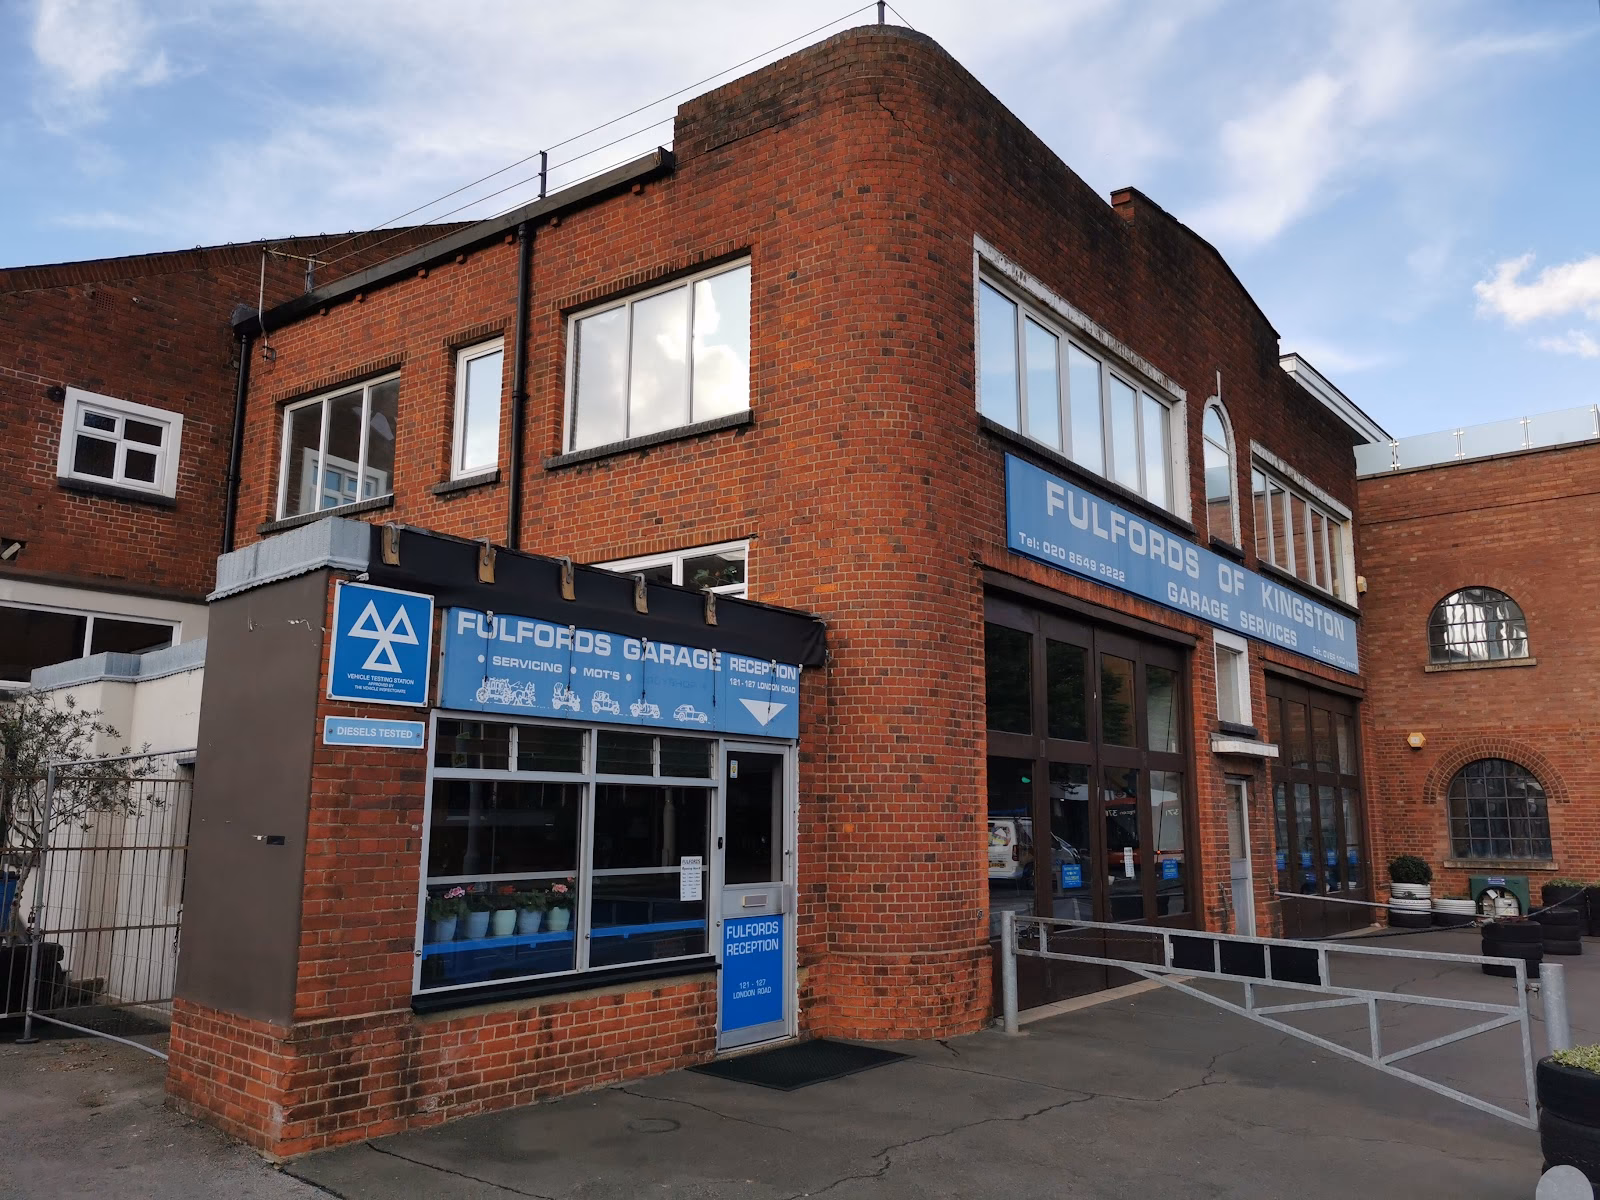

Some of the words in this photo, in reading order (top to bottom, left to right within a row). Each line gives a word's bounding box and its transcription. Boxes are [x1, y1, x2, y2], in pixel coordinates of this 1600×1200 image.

[1018, 531, 1040, 550] Tel:
[1043, 541, 1066, 560] 020
[1069, 551, 1097, 571] 8549
[1099, 563, 1125, 583] 3222
[1046, 480, 1200, 580] FULFORDS
[1218, 563, 1245, 597] OF
[1261, 582, 1345, 642] KINGSTON
[1167, 581, 1229, 622] GARAGE
[1239, 611, 1298, 647] SERVICES
[457, 610, 611, 657] FULFORDS
[623, 638, 722, 672] GARAGE
[492, 655, 563, 674] SERVICING
[729, 657, 796, 680] RECEPTION
[347, 673, 370, 681] VEHICLE
[371, 675, 393, 683] TESTING
[394, 677, 414, 685] STATION
[583, 667, 620, 681] MOT'S
[757, 681, 780, 692] LONDON
[781, 685, 796, 694] ROAD
[337, 726, 377, 737] DIESELS
[379, 728, 413, 739] TESTED
[726, 921, 779, 939] FULFORDS
[726, 938, 779, 956] RECEPTION
[733, 989, 756, 1000] LONDON
[757, 986, 772, 995] ROAD
[739, 981, 750, 990] 121
[755, 978, 766, 987] 127
